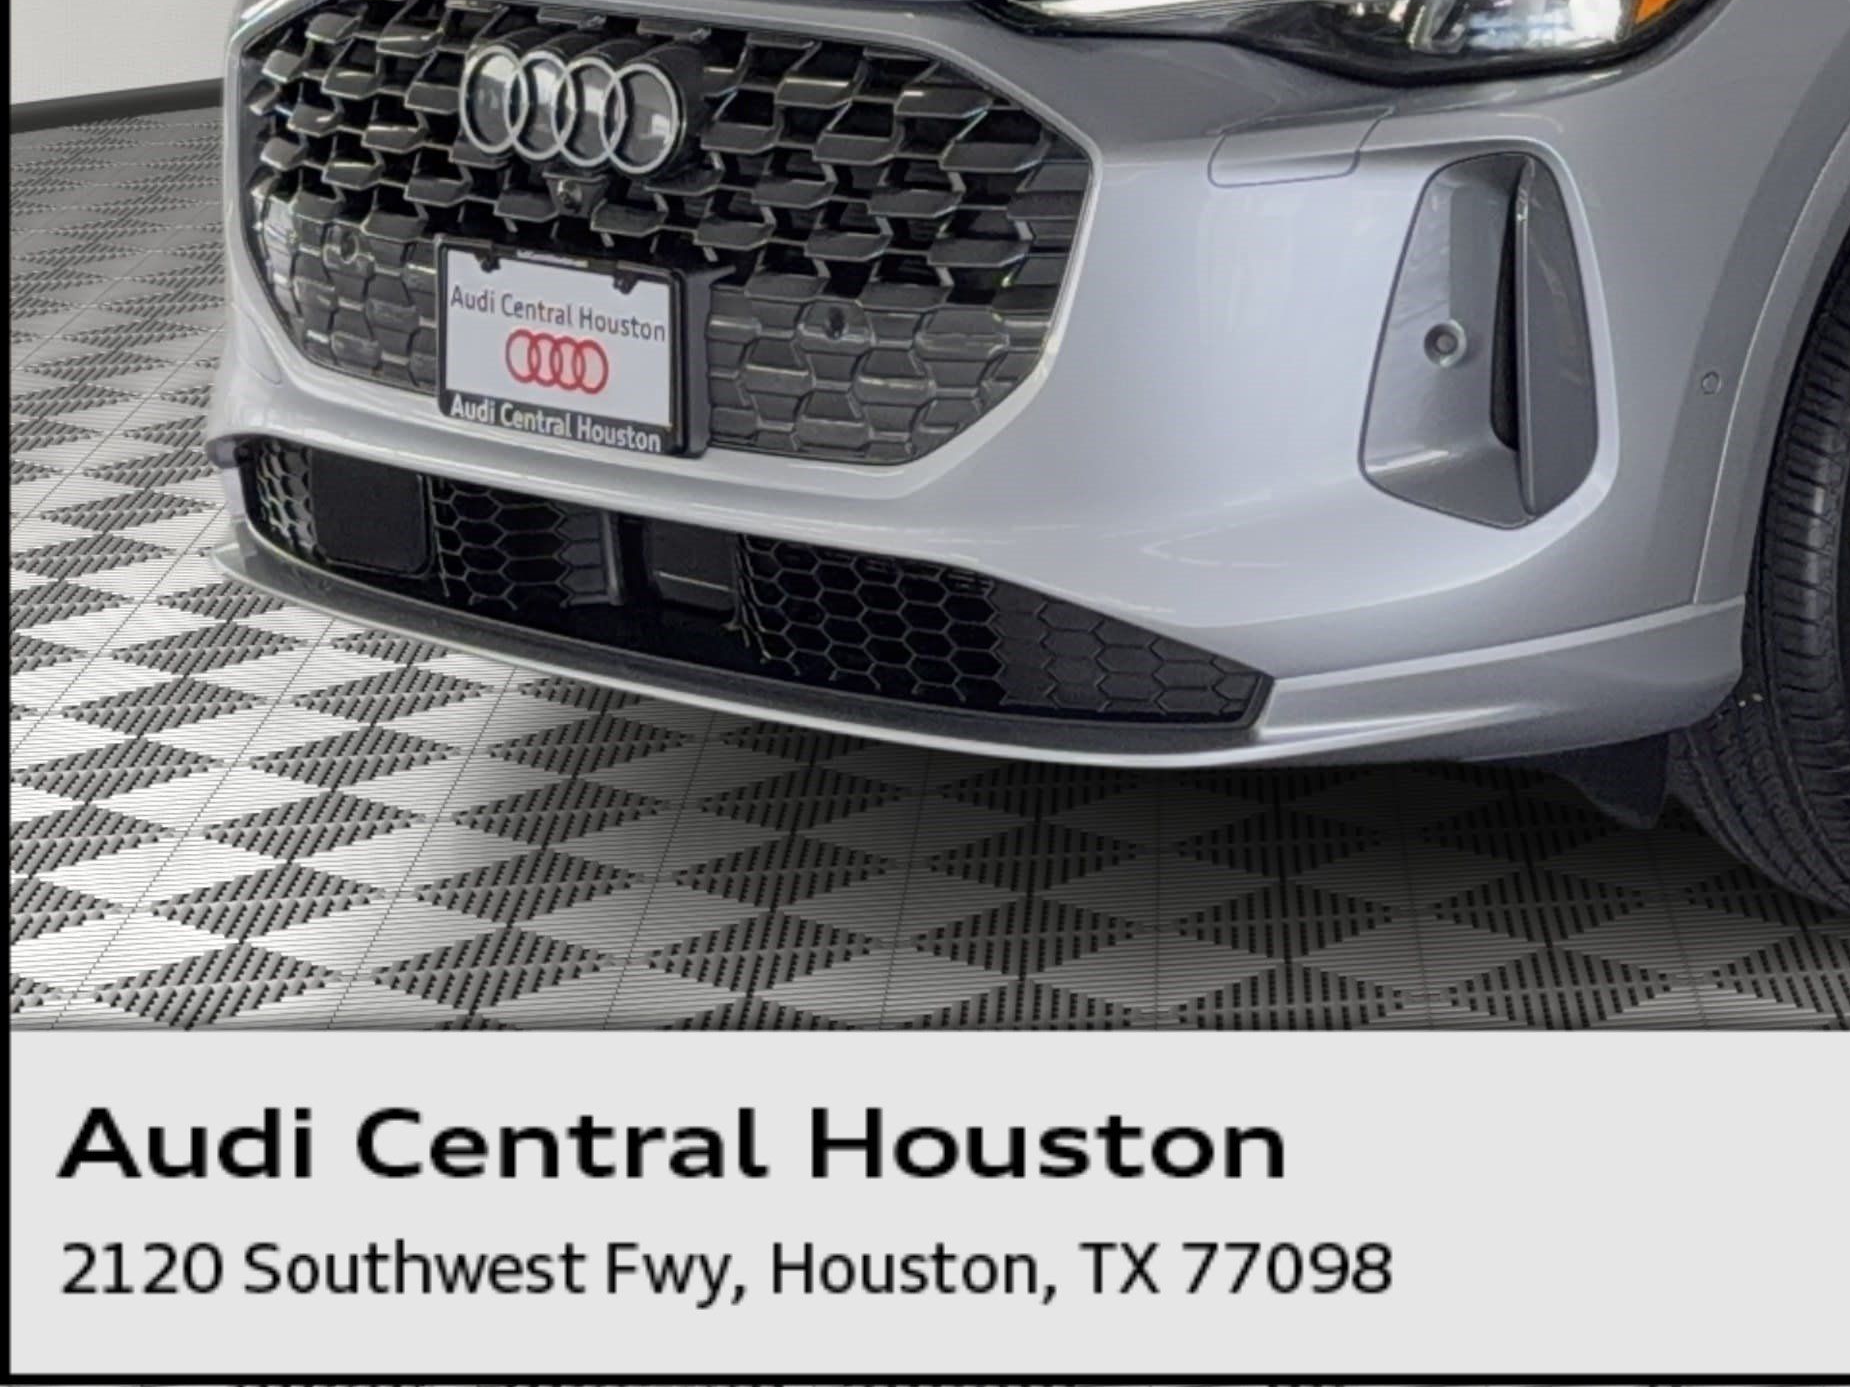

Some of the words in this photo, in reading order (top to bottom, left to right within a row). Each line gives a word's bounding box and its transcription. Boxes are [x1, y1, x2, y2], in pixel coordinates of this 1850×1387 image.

[450, 285, 496, 313] Audi
[501, 293, 572, 325] Central
[578, 307, 665, 342] Houston
[450, 393, 496, 423] Audi
[500, 403, 572, 437] Central
[577, 416, 662, 453] Houston
